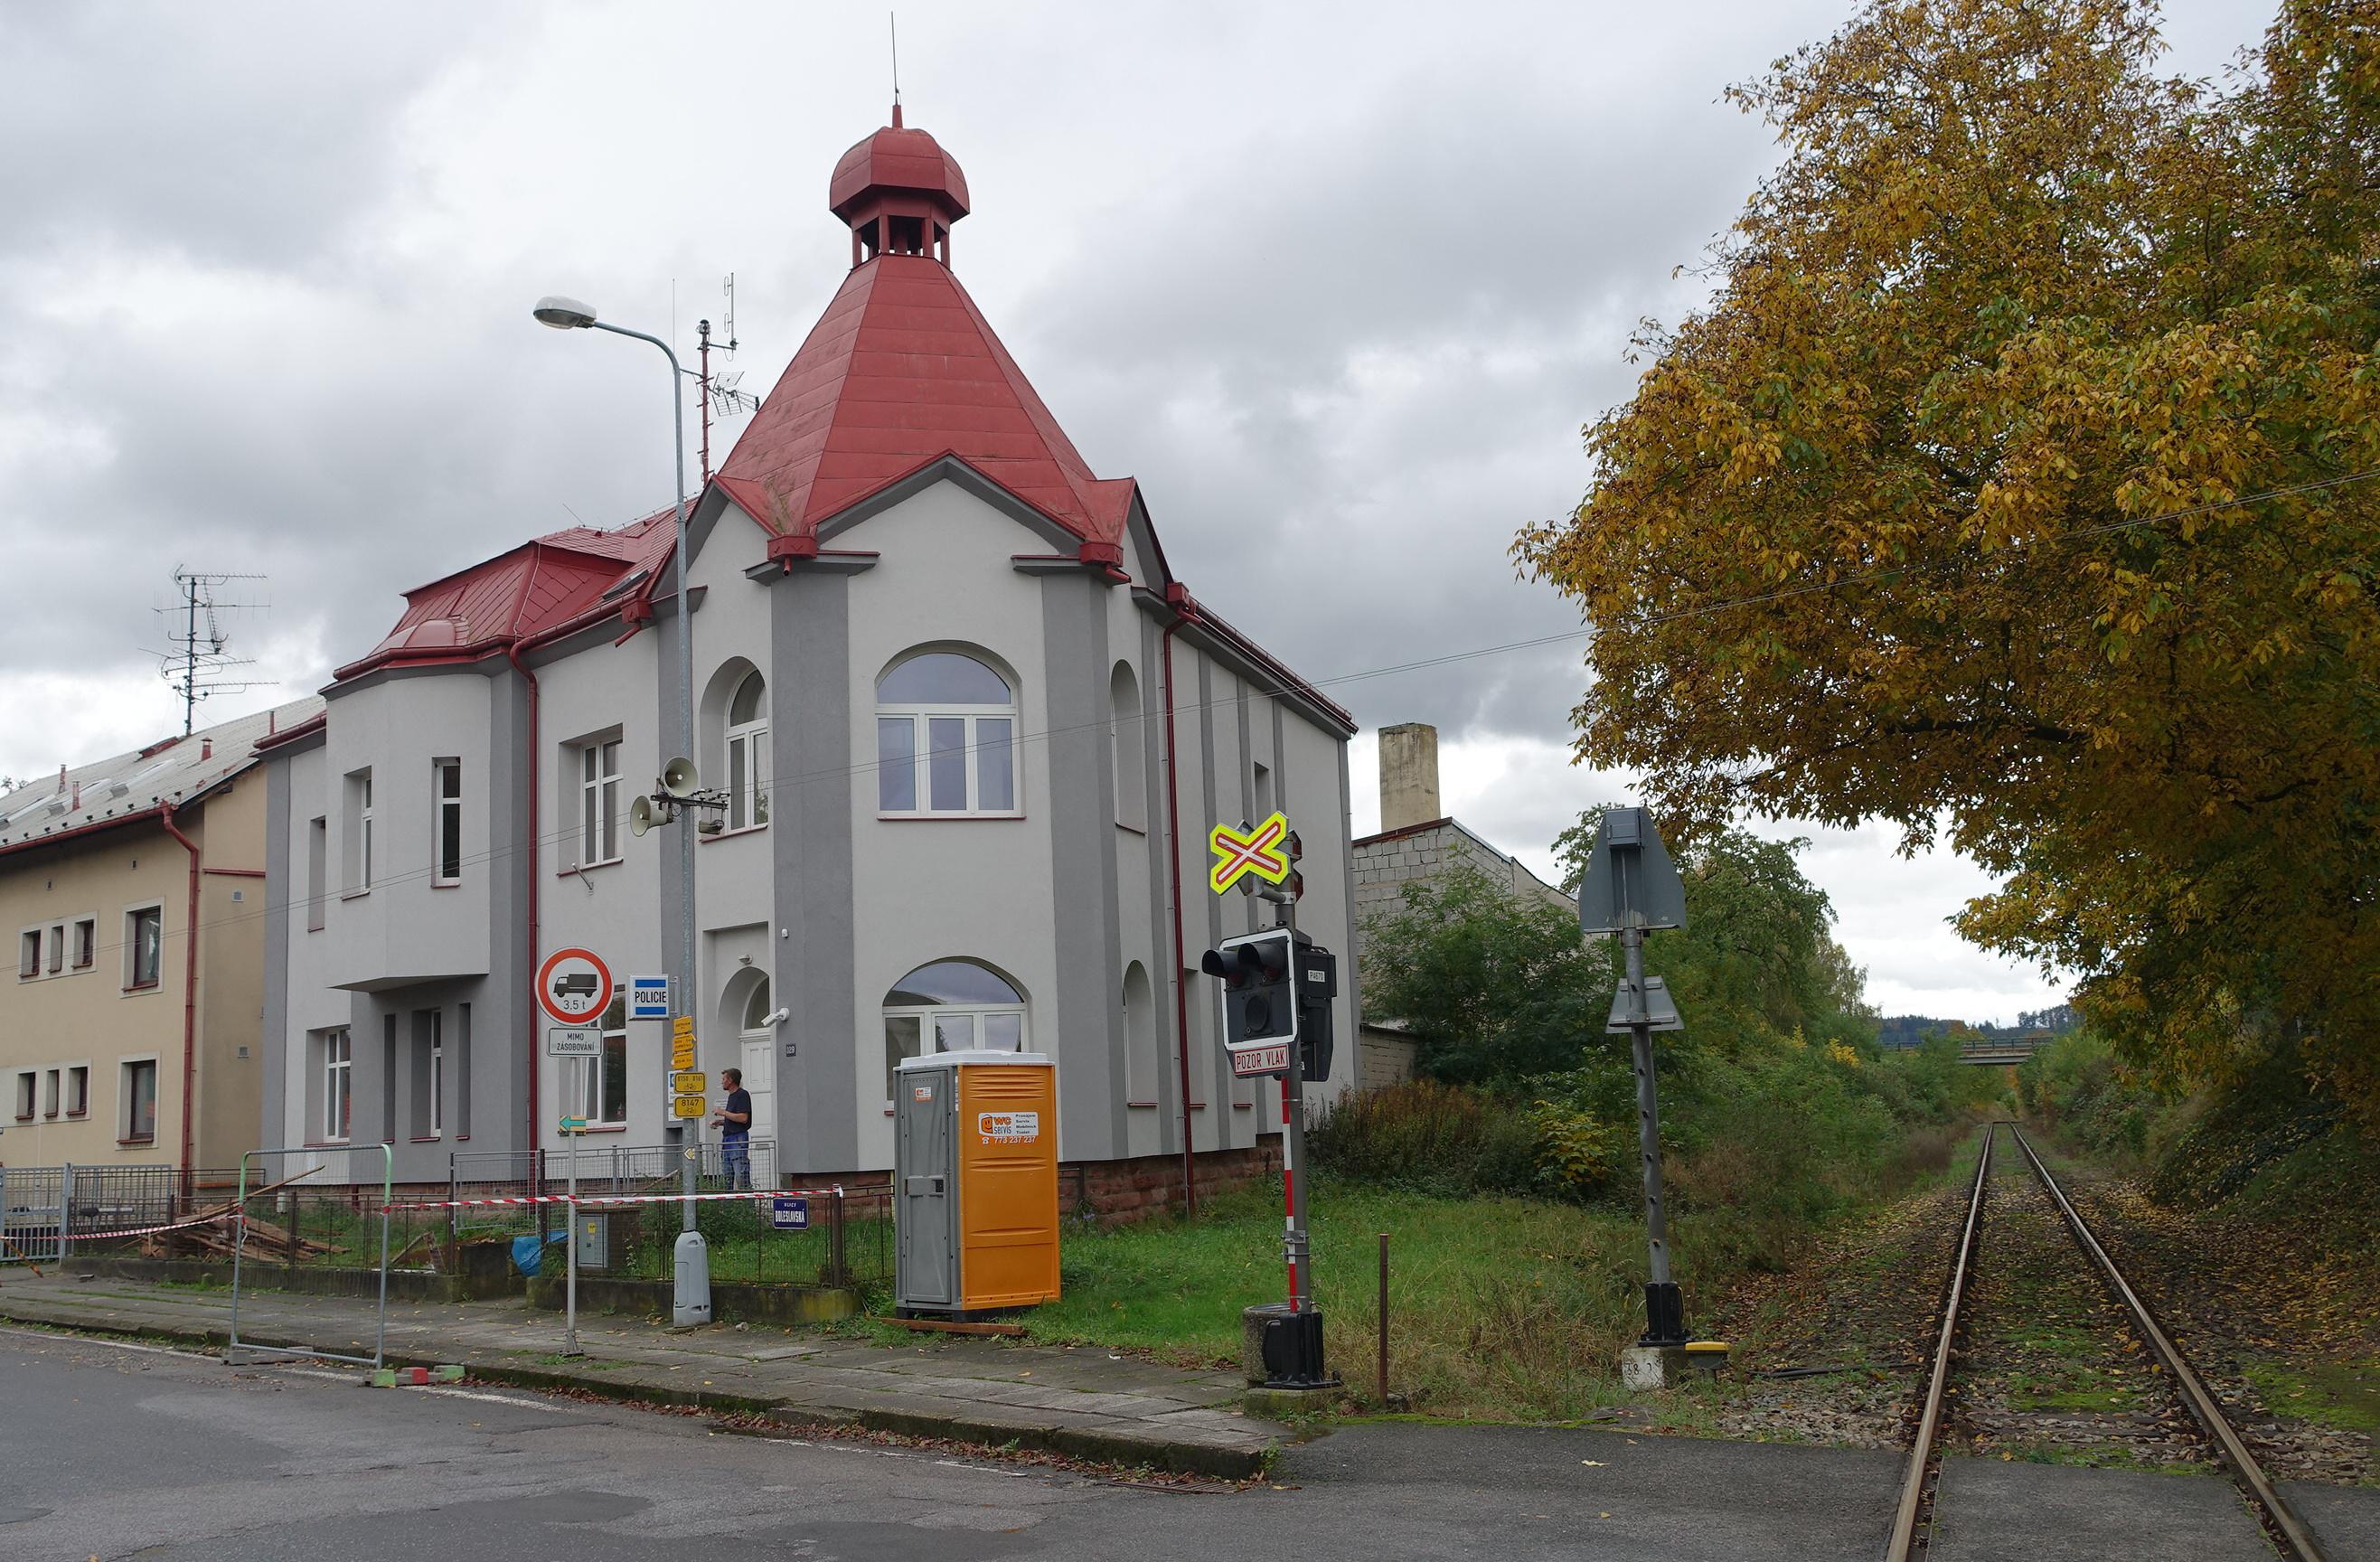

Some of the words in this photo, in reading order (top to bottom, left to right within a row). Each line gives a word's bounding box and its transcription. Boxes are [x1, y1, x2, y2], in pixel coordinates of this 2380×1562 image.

[635, 991, 667, 1003] POLICIE
[582, 1000, 586, 1010] t
[567, 1032, 585, 1040] MIMO
[557, 1042, 595, 1051] ZÁSOBOVÁNÍ
[1236, 1052, 1262, 1070] POZOR
[1265, 1049, 1285, 1067] VLAK
[994, 1116, 1012, 1125] WC
[993, 1125, 1012, 1134] servis
[1009, 1135, 1022, 1143] 237
[1023, 1135, 1036, 1143] 237
